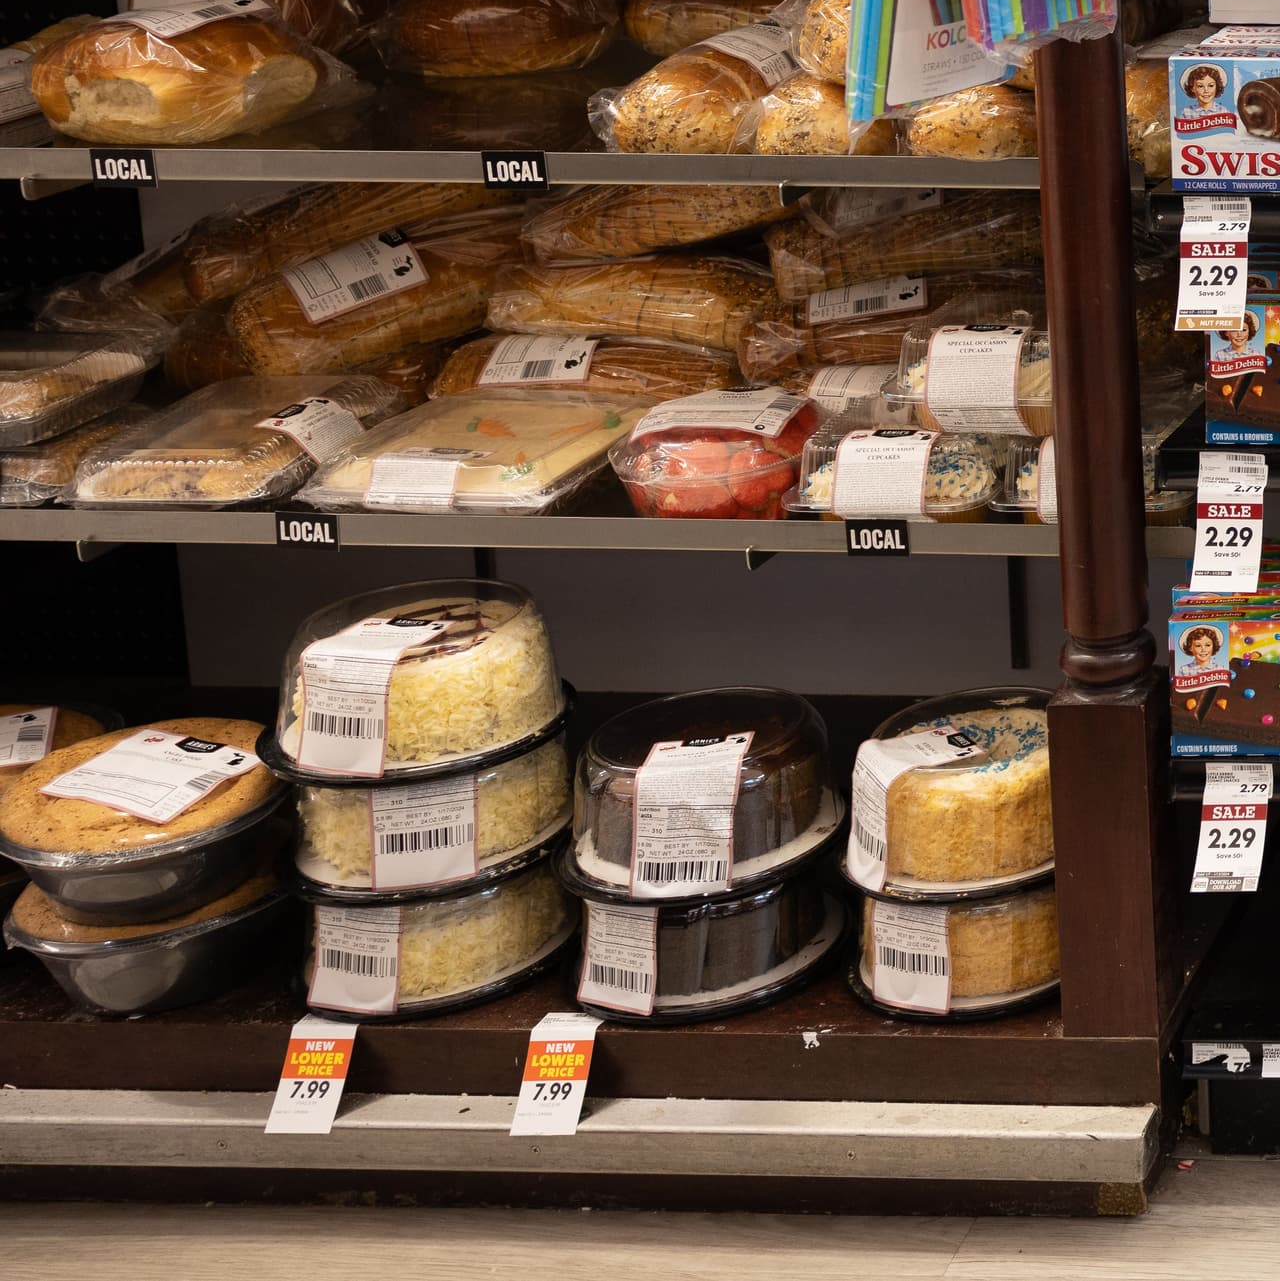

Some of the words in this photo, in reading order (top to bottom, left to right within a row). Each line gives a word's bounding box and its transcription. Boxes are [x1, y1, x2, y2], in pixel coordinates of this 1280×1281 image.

[1176, 119, 1202, 132] Little
[1204, 115, 1235, 129] Debbie
[95, 156, 153, 182] LOCAL
[486, 160, 543, 185] LOCAL
[1184, 181, 1192, 190] 12
[1192, 181, 1207, 190] CAKE
[1208, 181, 1227, 190] ROLLS
[1232, 181, 1249, 191] TWIN
[1249, 181, 1278, 191] WRAPPED
[1191, 243, 1236, 256] SALE
[1188, 265, 1238, 287] 2.29
[279, 519, 336, 544] LOCAL
[849, 527, 905, 551] LOCAL
[305, 1040, 336, 1051] NEW
[290, 1052, 344, 1065] LOWER
[298, 1066, 334, 1075] PRICE
[289, 1080, 331, 1099] 7.99
